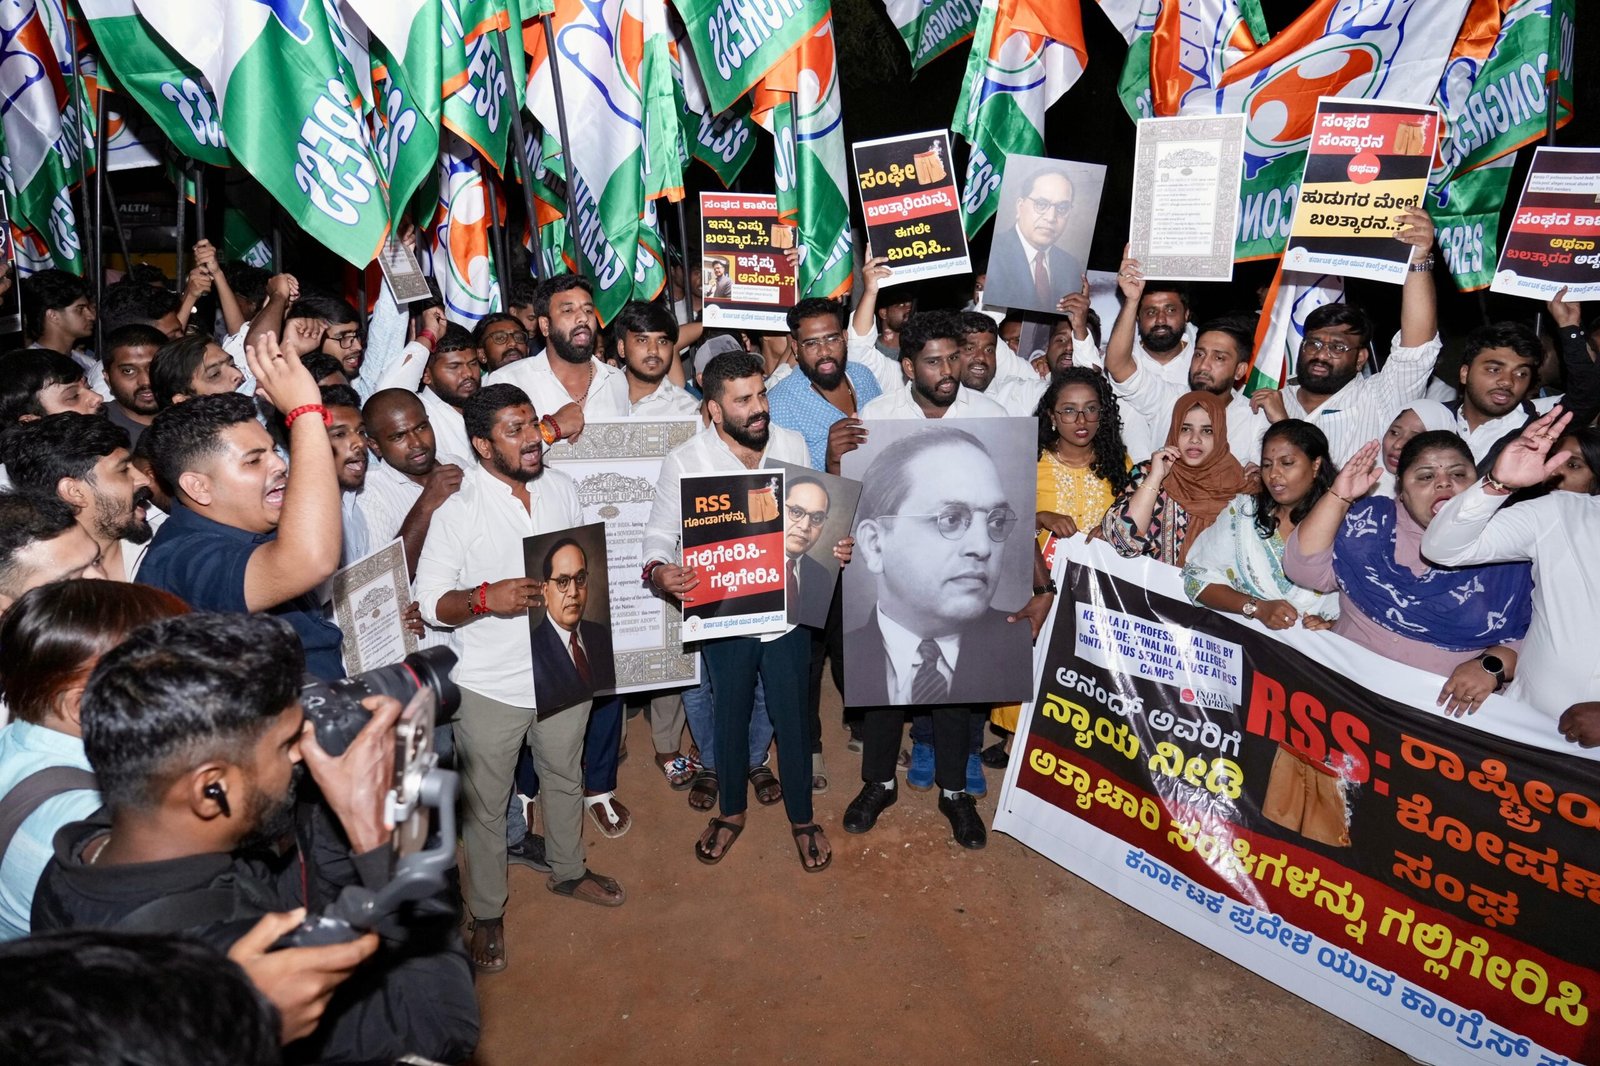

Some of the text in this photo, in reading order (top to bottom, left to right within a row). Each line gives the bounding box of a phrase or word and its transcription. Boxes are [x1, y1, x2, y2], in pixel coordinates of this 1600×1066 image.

[1321, 113, 1370, 131] ಸಂಘದ
[704, 200, 740, 211] ಸಂಘದ
[1302, 190, 1370, 208] ಹುಡುಗರ
[1517, 212, 1570, 228] ಸಂಘದ
[895, 223, 931, 238] ಈಗಲೇ
[1550, 237, 1595, 251] ಅಥವಾ
[695, 494, 732, 513] RSS
[1223, 647, 1234, 659] BY
[1140, 663, 1174, 681] CAMPS
[1056, 666, 1144, 717] ಆನಂದ್
[1042, 693, 1142, 760] ನ್ಯಾಯ
[1149, 708, 1242, 757] ಅವರಿಗೆ
[1246, 670, 1392, 797] RSS:
[1149, 741, 1244, 800] ನೀಡಿ
[1028, 746, 1161, 831] ಅತ್ಯಾಚಾರಿ
[1379, 906, 1589, 1026] ಗಲ್ಲಿಗೇರಿಸಿ
[1392, 850, 1520, 928] ಸಂಘ
[1125, 849, 1531, 1058] ಕರ್ನಾಟಕ ಪ್ರದೇಶ ಯುವ ಕಾಂಗ್ರೆಸ್
